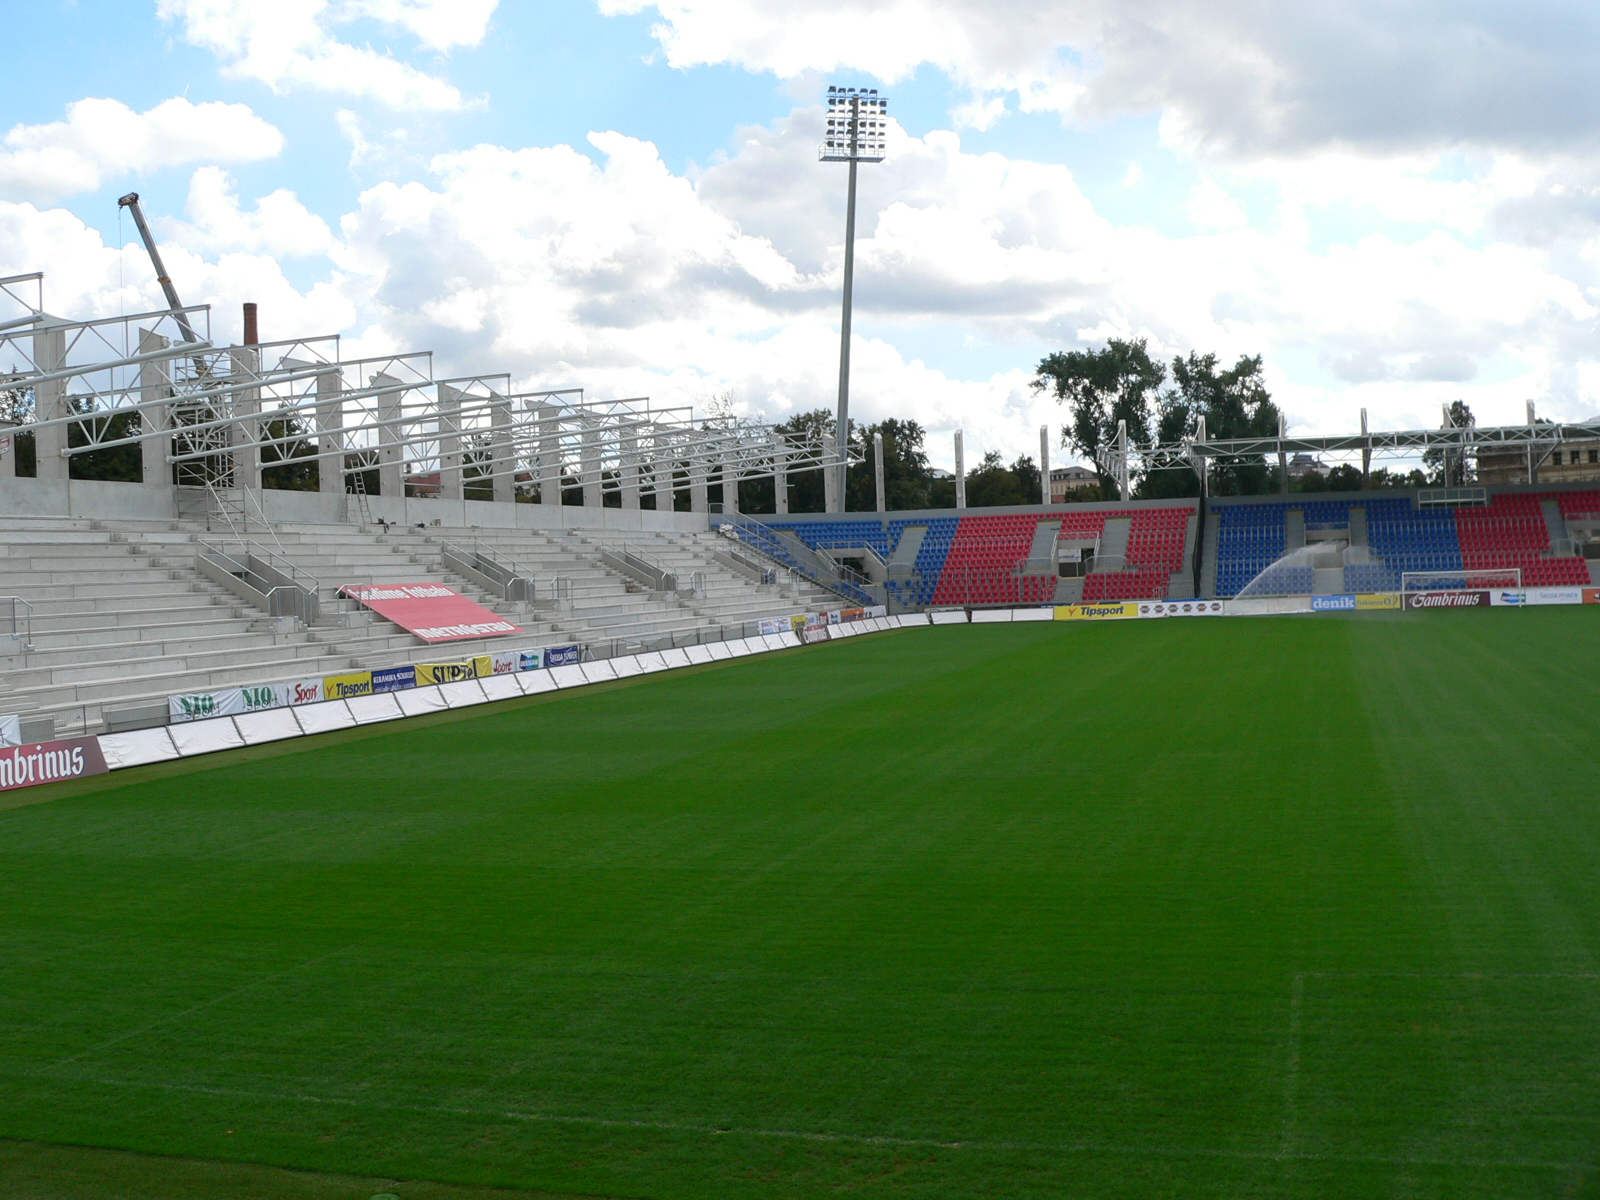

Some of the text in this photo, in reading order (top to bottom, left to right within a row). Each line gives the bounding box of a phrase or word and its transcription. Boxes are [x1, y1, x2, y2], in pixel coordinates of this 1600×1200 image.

[1312, 597, 1355, 609] deník
[1409, 592, 1480, 608] Gambrinus
[1081, 605, 1124, 617] Tipsport
[241, 686, 272, 706] NIO
[294, 683, 319, 703] Sport
[336, 680, 370, 697] Tipsport
